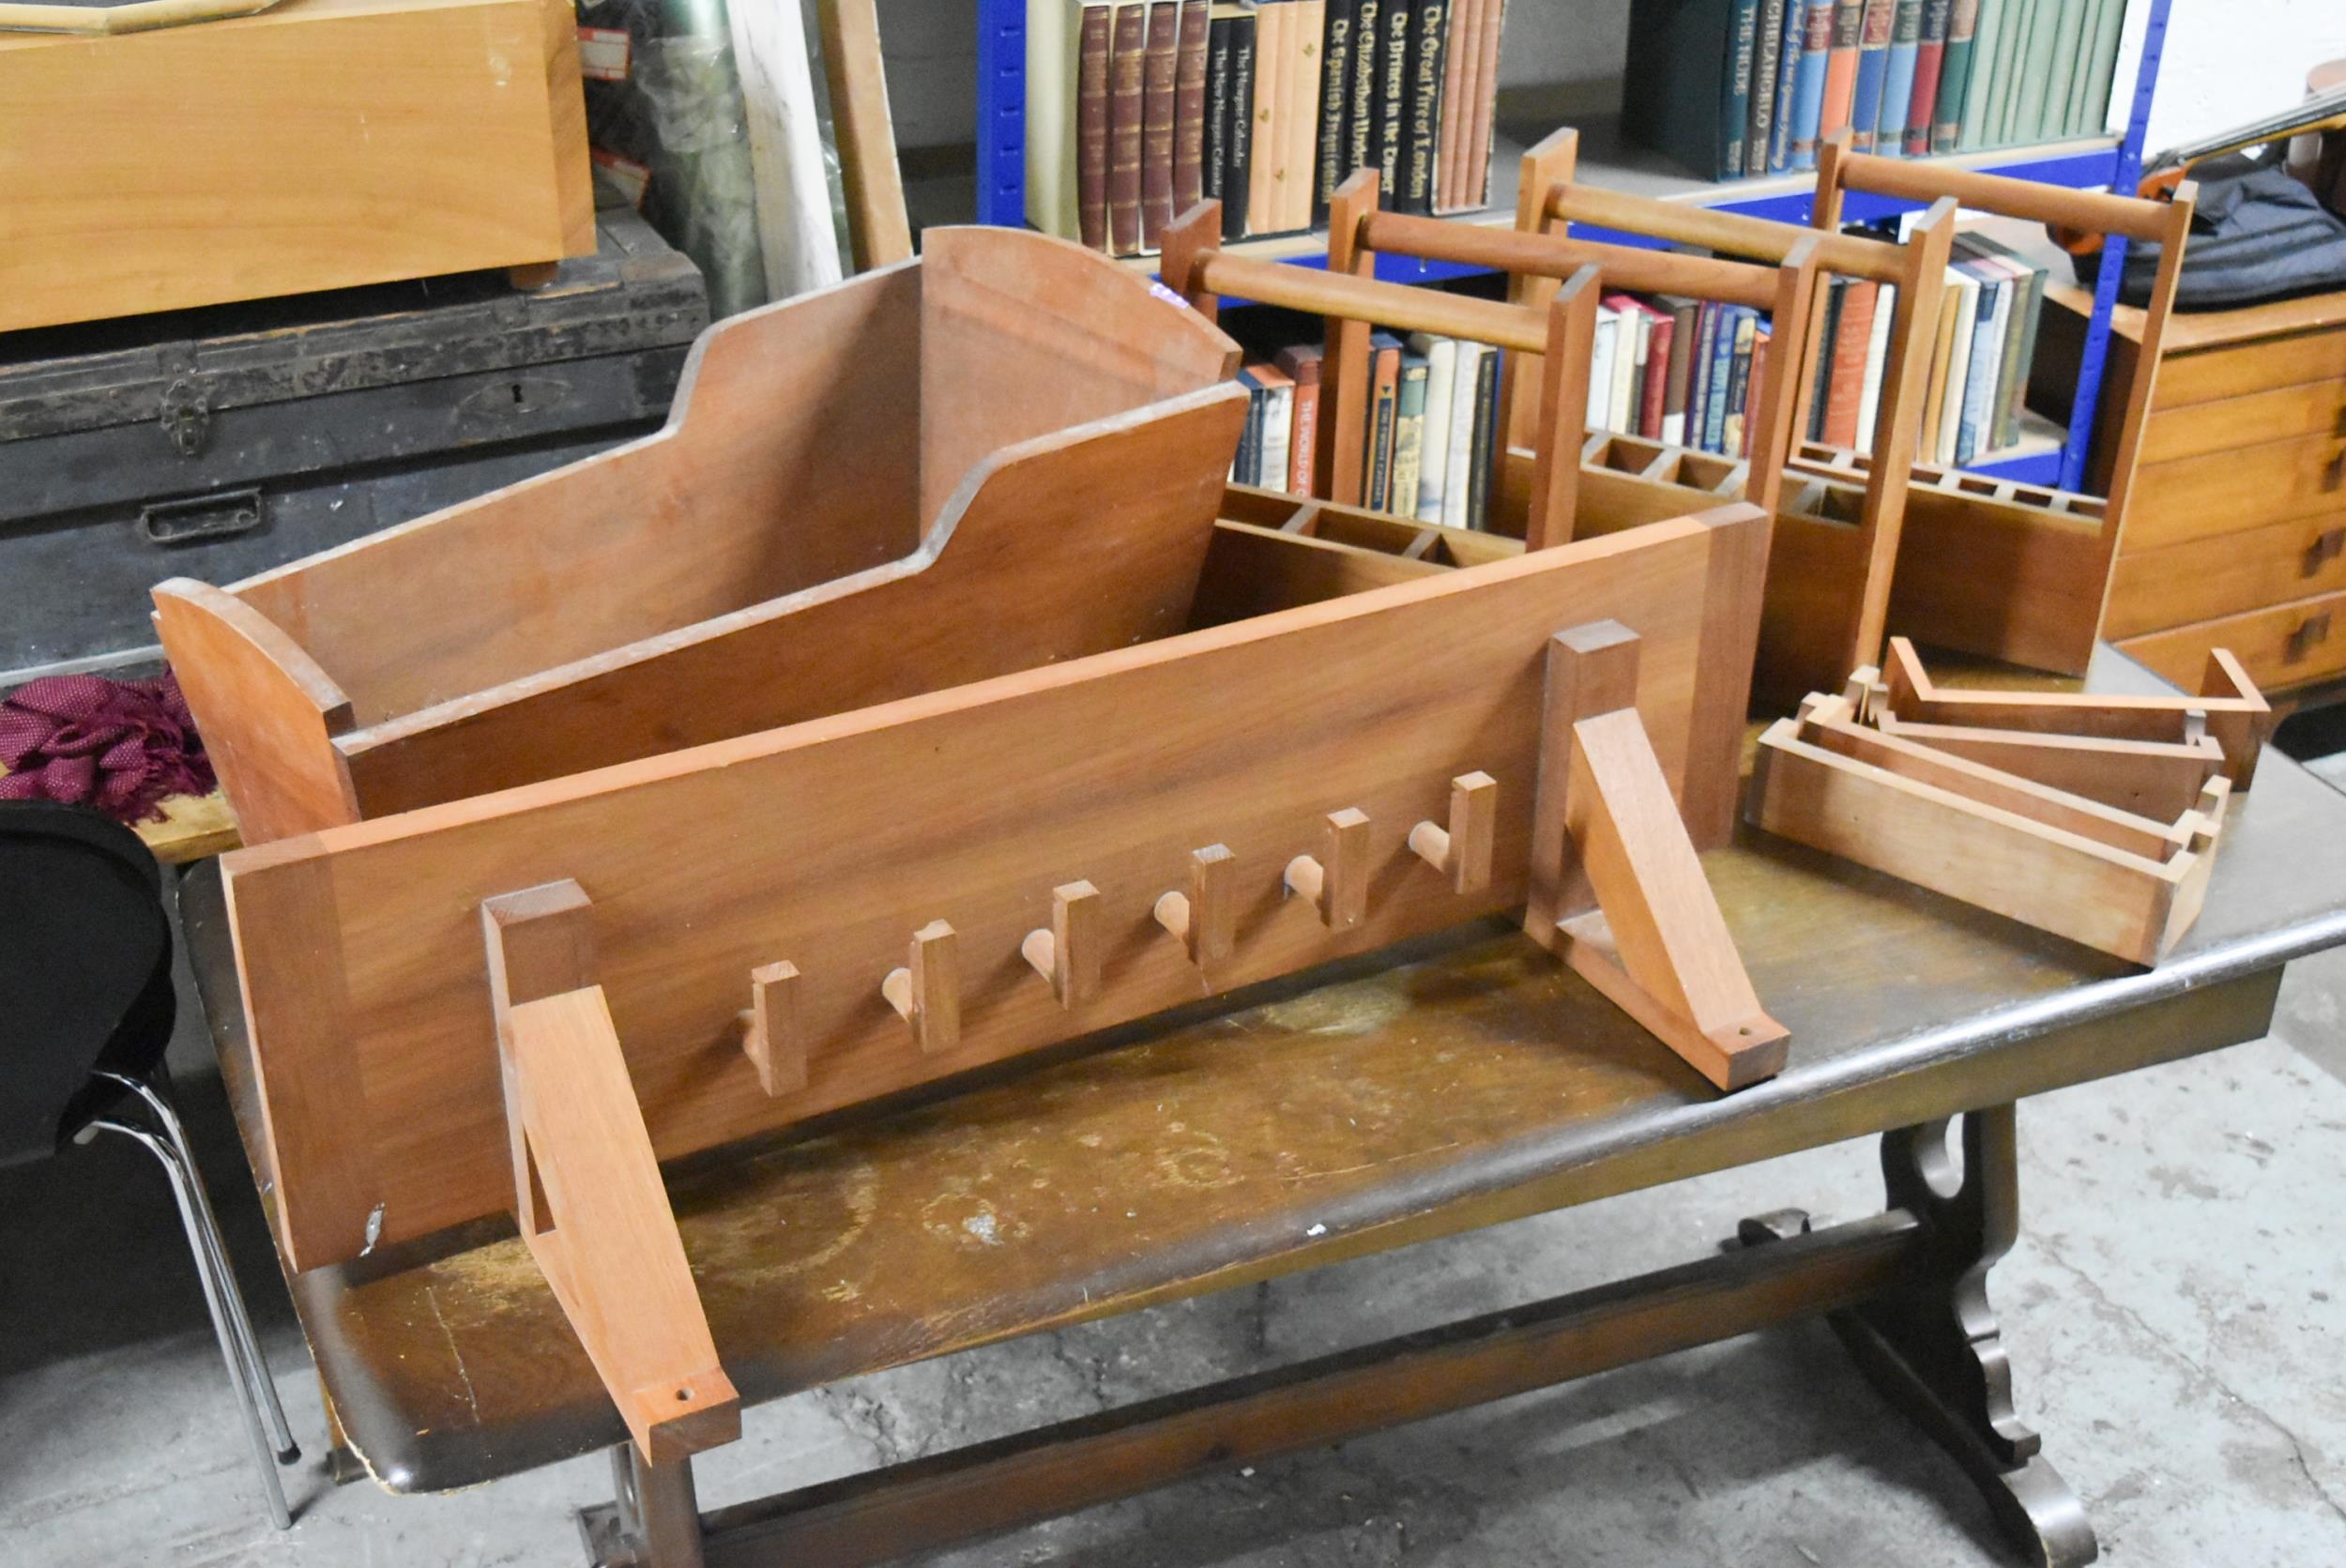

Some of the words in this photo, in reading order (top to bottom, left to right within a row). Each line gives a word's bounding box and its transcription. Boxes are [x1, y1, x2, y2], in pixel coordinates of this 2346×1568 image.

[1332, 19, 1349, 44] The
[1361, 2, 1378, 29] The
[1390, 11, 1409, 38] The
[1423, 6, 1442, 36] The
[1738, 7, 1755, 42] THE
[1355, 31, 1376, 117] Elizabethan
[1386, 39, 1407, 100] Princes
[1418, 37, 1440, 83] Great
[1733, 46, 1752, 97] NUDE
[1326, 46, 1347, 110] Spanish
[1385, 102, 1402, 118] in
[1415, 84, 1437, 117] Fire
[1351, 118, 1371, 170] Under
[1383, 121, 1399, 143] the
[1413, 119, 1430, 134] of
[1380, 145, 1397, 196] Tower
[1409, 137, 1432, 199] London
